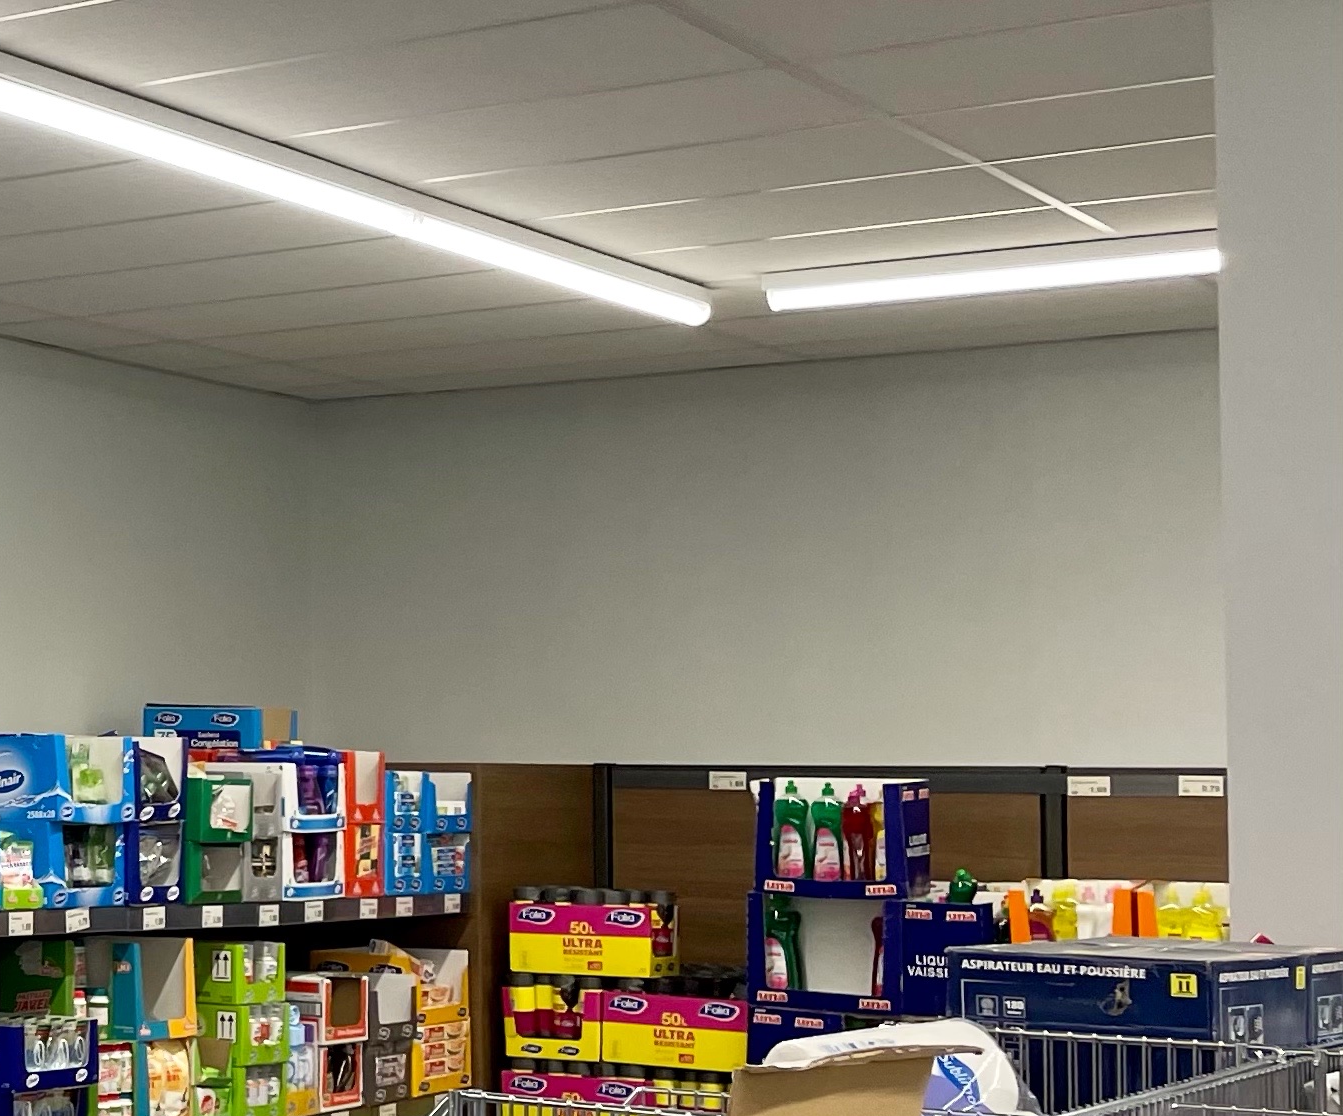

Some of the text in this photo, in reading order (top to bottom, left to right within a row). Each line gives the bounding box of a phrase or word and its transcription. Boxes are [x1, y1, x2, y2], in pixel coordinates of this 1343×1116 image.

[562, 938, 603, 949] ULTRA
[915, 955, 947, 966] LIQU
[907, 966, 949, 978] VAISS
[961, 958, 1147, 979] ASPIRATEUR EAU ET POUSSIÈRE
[653, 1028, 695, 1041] ULTRA
